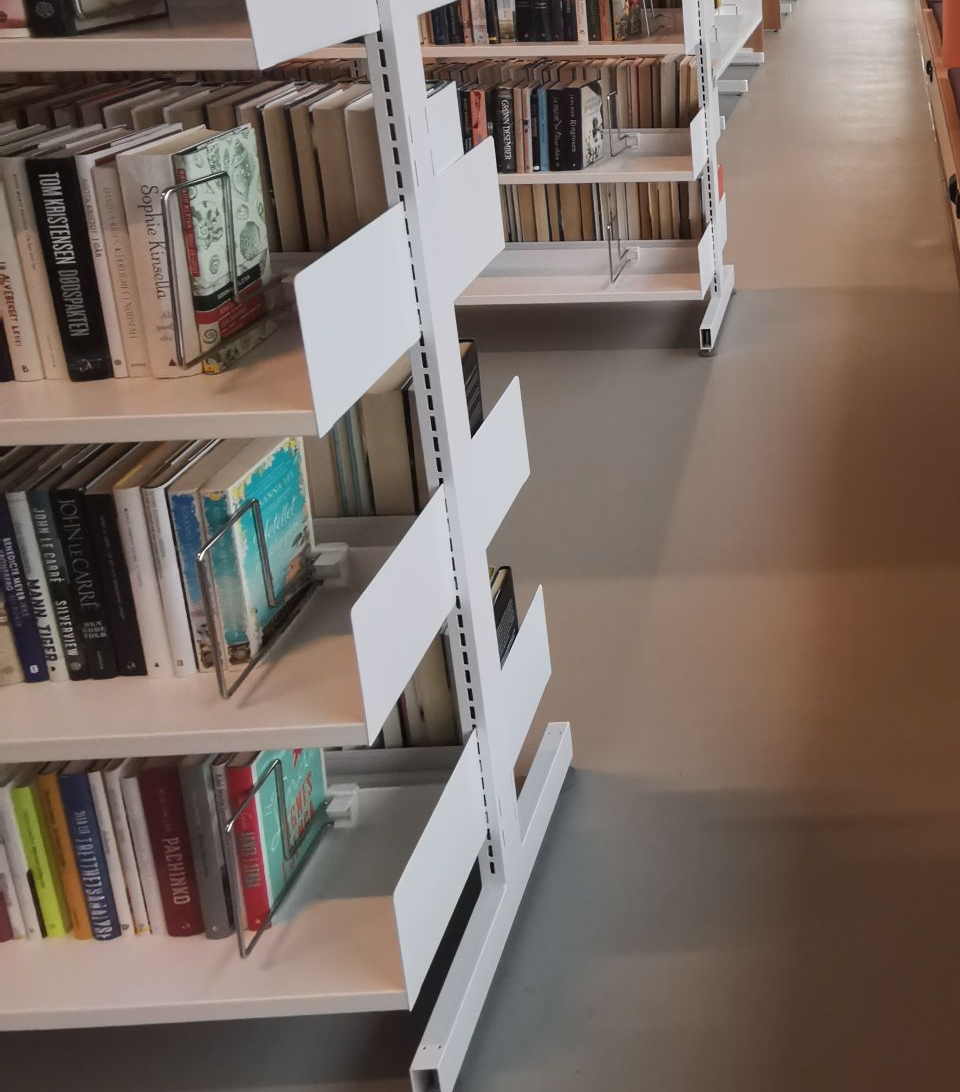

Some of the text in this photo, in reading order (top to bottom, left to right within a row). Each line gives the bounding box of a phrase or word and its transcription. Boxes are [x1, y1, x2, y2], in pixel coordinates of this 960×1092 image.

[501, 99, 512, 160] GRØNN DESEMBER
[38, 172, 91, 337] TOM KRISTENSEN DØDSPAKTEN
[93, 244, 103, 258] GÅR
[138, 184, 171, 299] Sophie Kinsella
[3, 537, 20, 575] BENEDICTE
[13, 577, 26, 600] MEYER
[32, 508, 79, 656] JOHN LE CARRÉ SILVERVIEW
[57, 498, 101, 610] JOHN LE CARRÉ
[26, 579, 58, 663] MANN TIGER
[162, 837, 191, 906] PACHINKO
